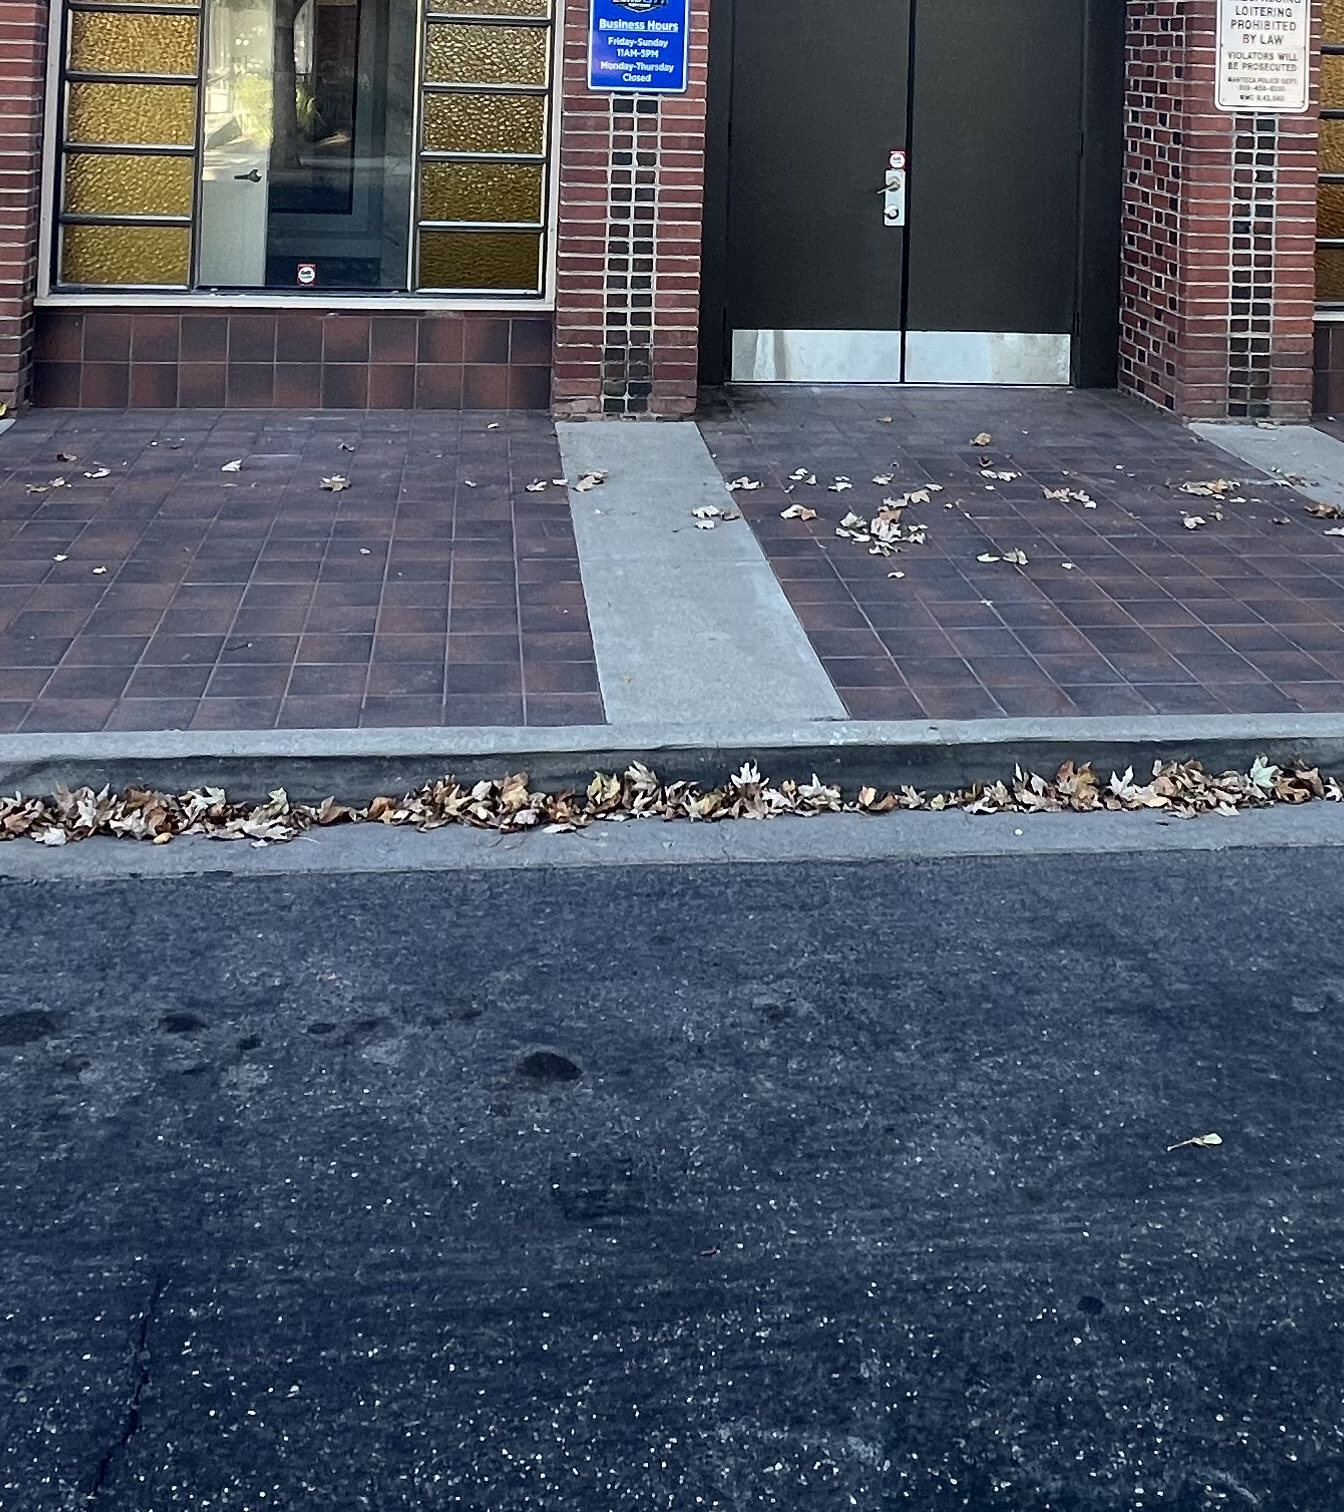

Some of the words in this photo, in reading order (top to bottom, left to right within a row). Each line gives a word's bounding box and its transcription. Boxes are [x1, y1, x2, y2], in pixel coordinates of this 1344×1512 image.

[1235, 5, 1293, 18] LOITERING
[599, 18, 646, 30] Business
[647, 19, 679, 32] Hours
[1230, 19, 1297, 31] PROHIBITED
[607, 36, 669, 48] Friday-Sunday
[1242, 33, 1257, 44] BY
[1260, 33, 1284, 45] LAW
[1227, 51, 1274, 61] VIOLATORS
[1277, 52, 1298, 62] WILL
[600, 60, 675, 73] Monday-Thursday
[1227, 61, 1239, 70] BE
[1241, 62, 1297, 72] PROSECUTED
[622, 72, 652, 83] Closed
